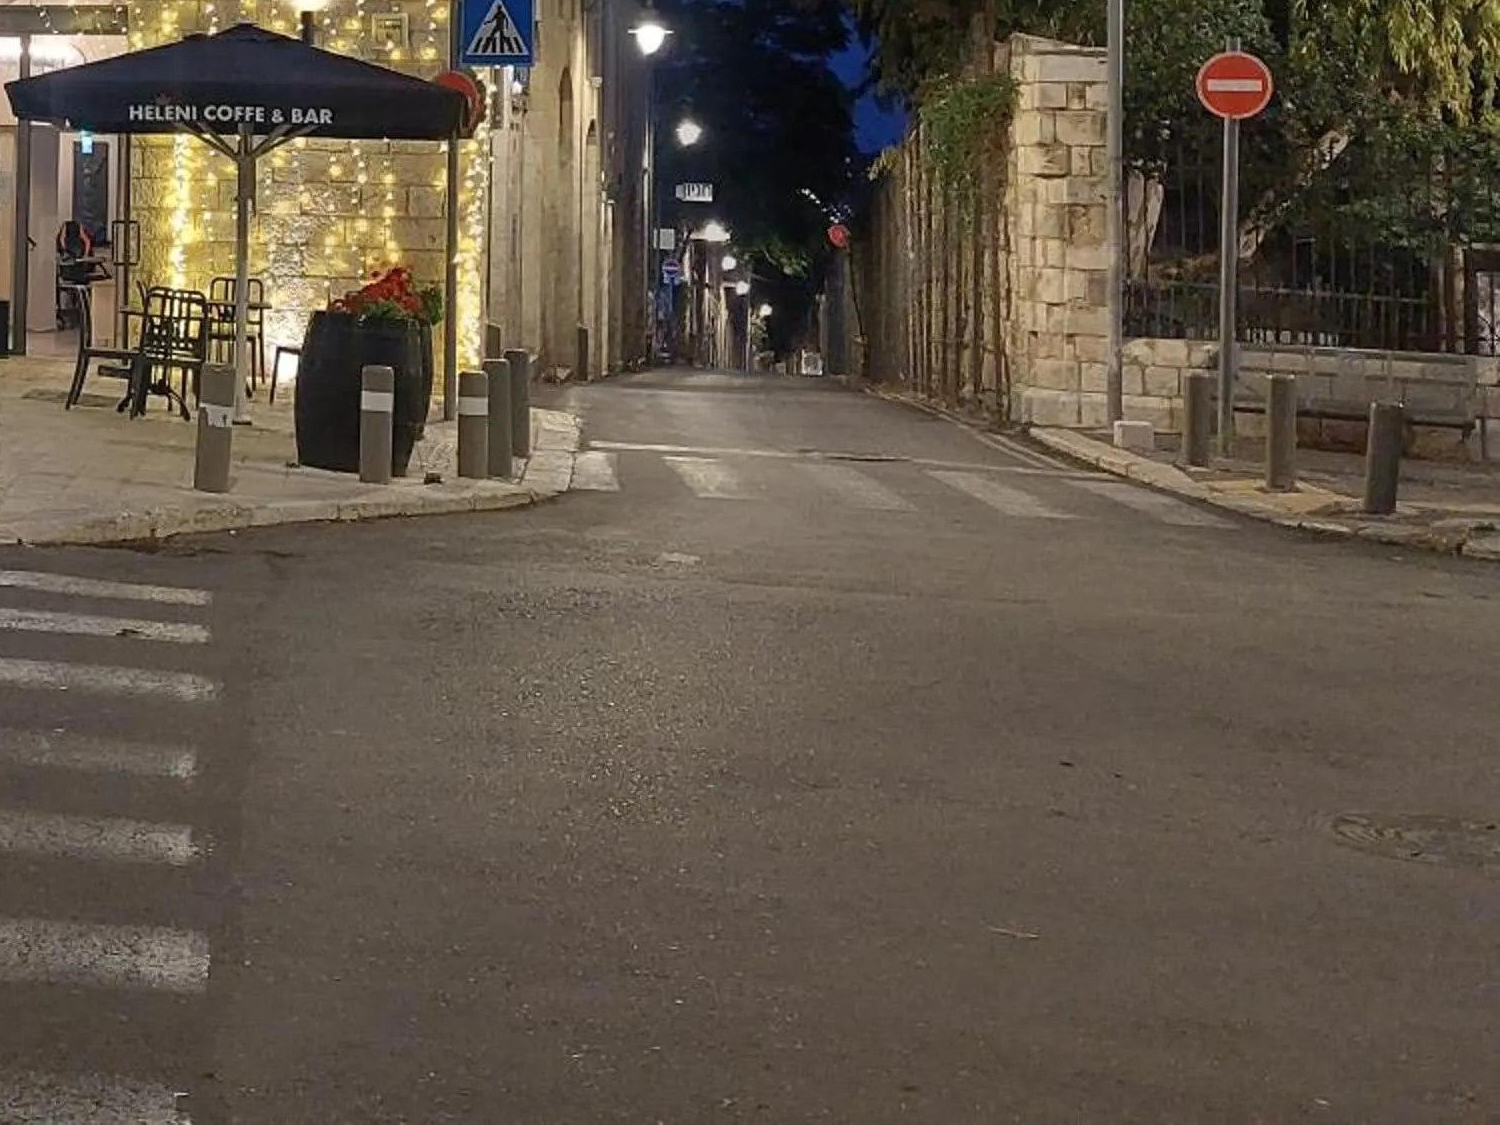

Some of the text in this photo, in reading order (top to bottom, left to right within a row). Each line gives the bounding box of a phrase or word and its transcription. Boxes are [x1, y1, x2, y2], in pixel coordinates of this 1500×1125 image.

[128, 104, 334, 124] HELENI COFFE & BAR
